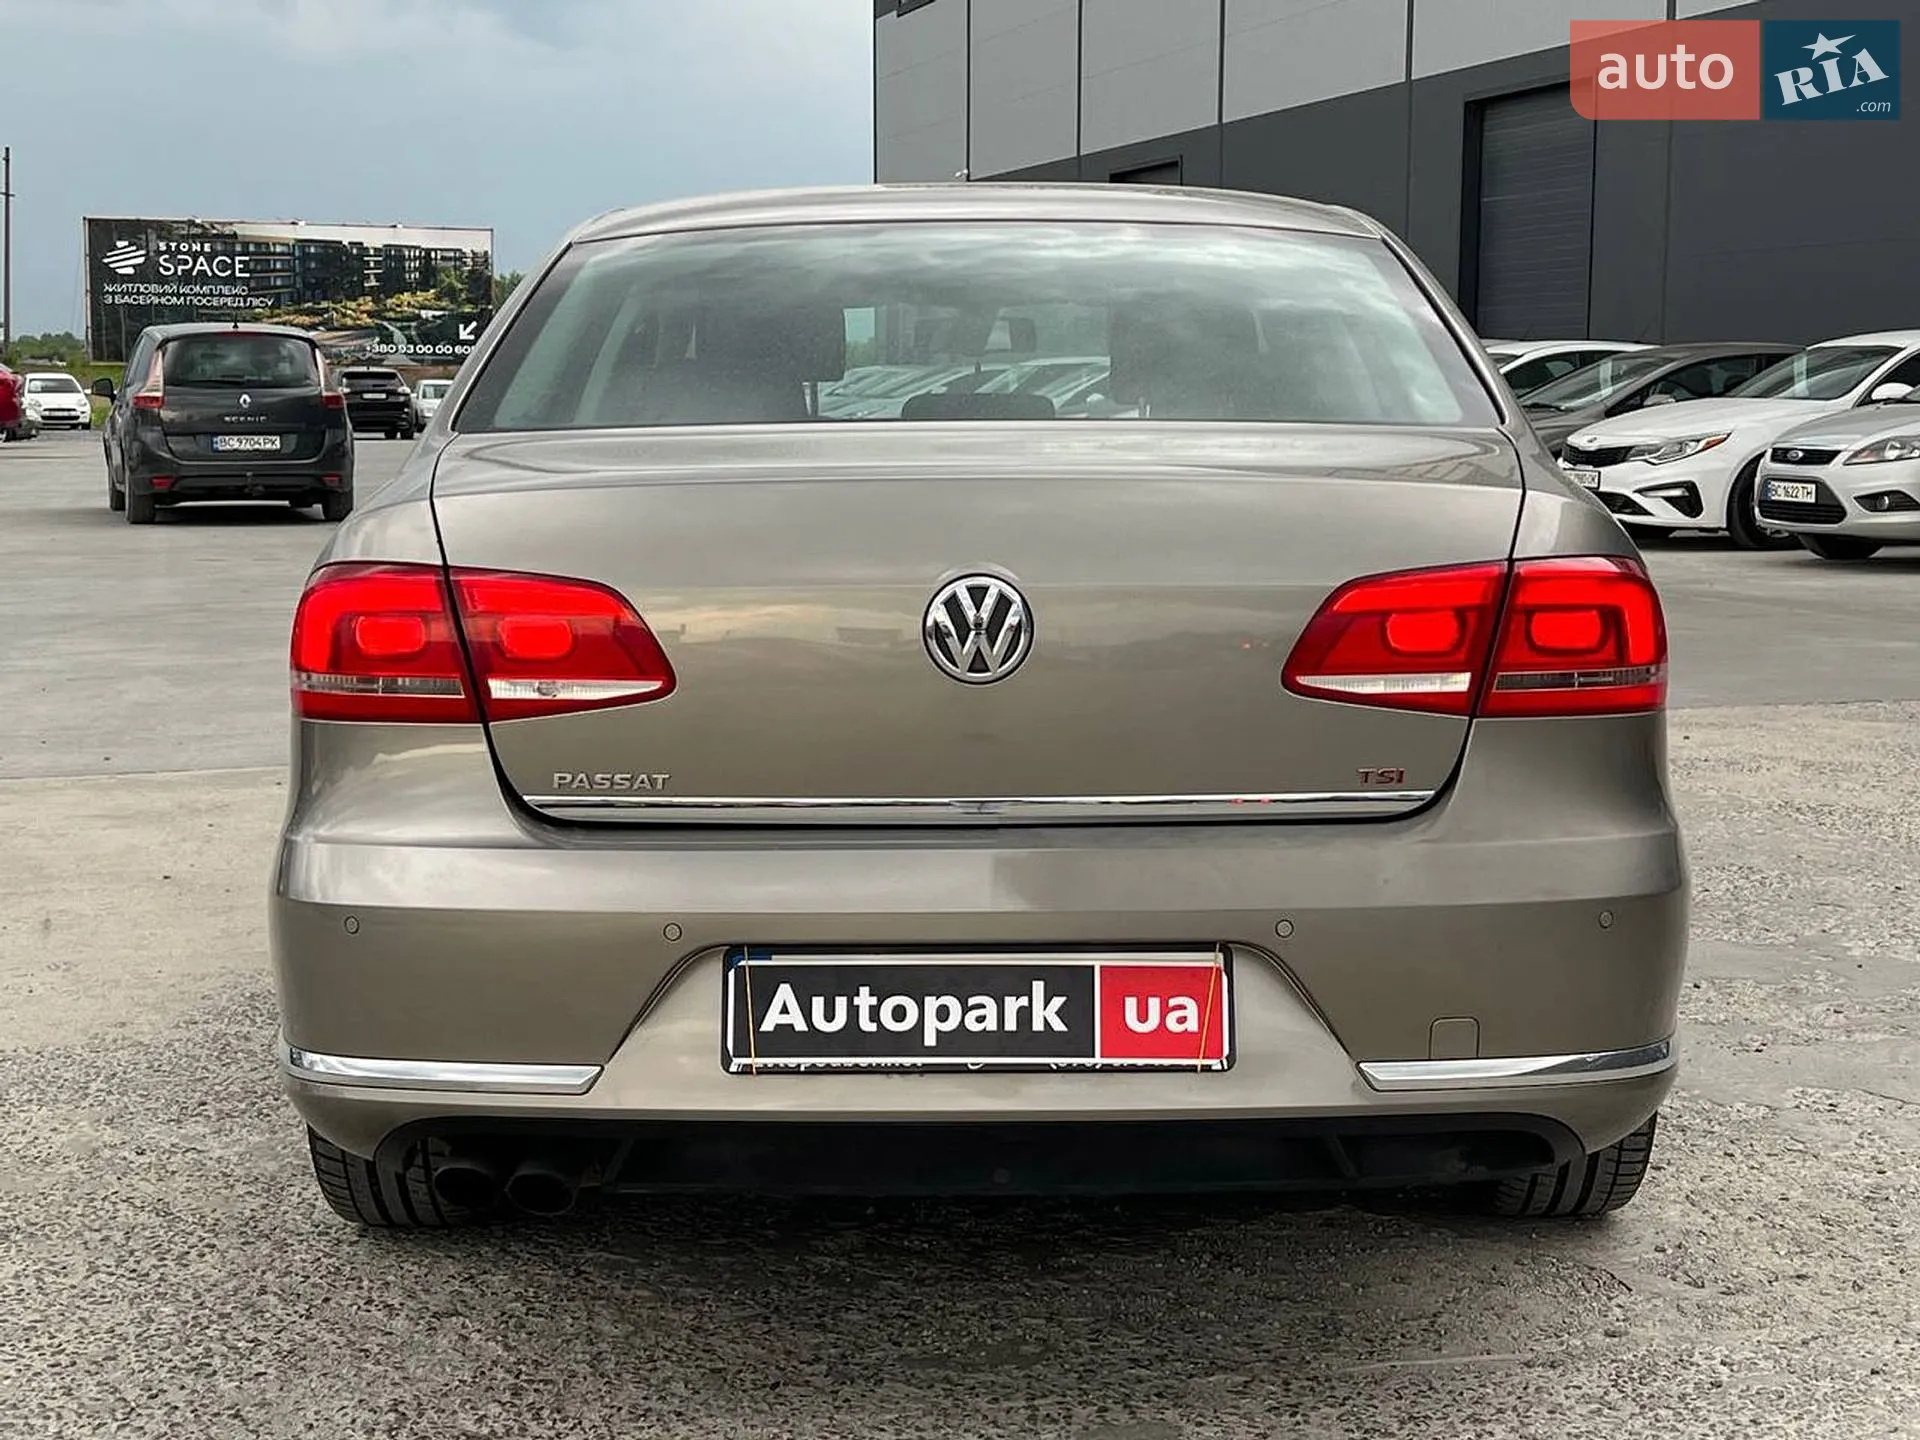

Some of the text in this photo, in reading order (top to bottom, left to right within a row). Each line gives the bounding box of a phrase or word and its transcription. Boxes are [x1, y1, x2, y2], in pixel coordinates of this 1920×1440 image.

[158, 242, 212, 252] STONE
[158, 255, 250, 277] SPACE
[103, 283, 249, 296] ЖИТЛОВИЙ КОМПЛЕКС
[114, 295, 185, 306] БАСЕЙНОМ
[186, 296, 244, 307] ПОСЕРЕД
[552, 772, 670, 790] PASSAT
[1358, 768, 1404, 784] TSI
[758, 981, 1200, 1047] Autopark ua
